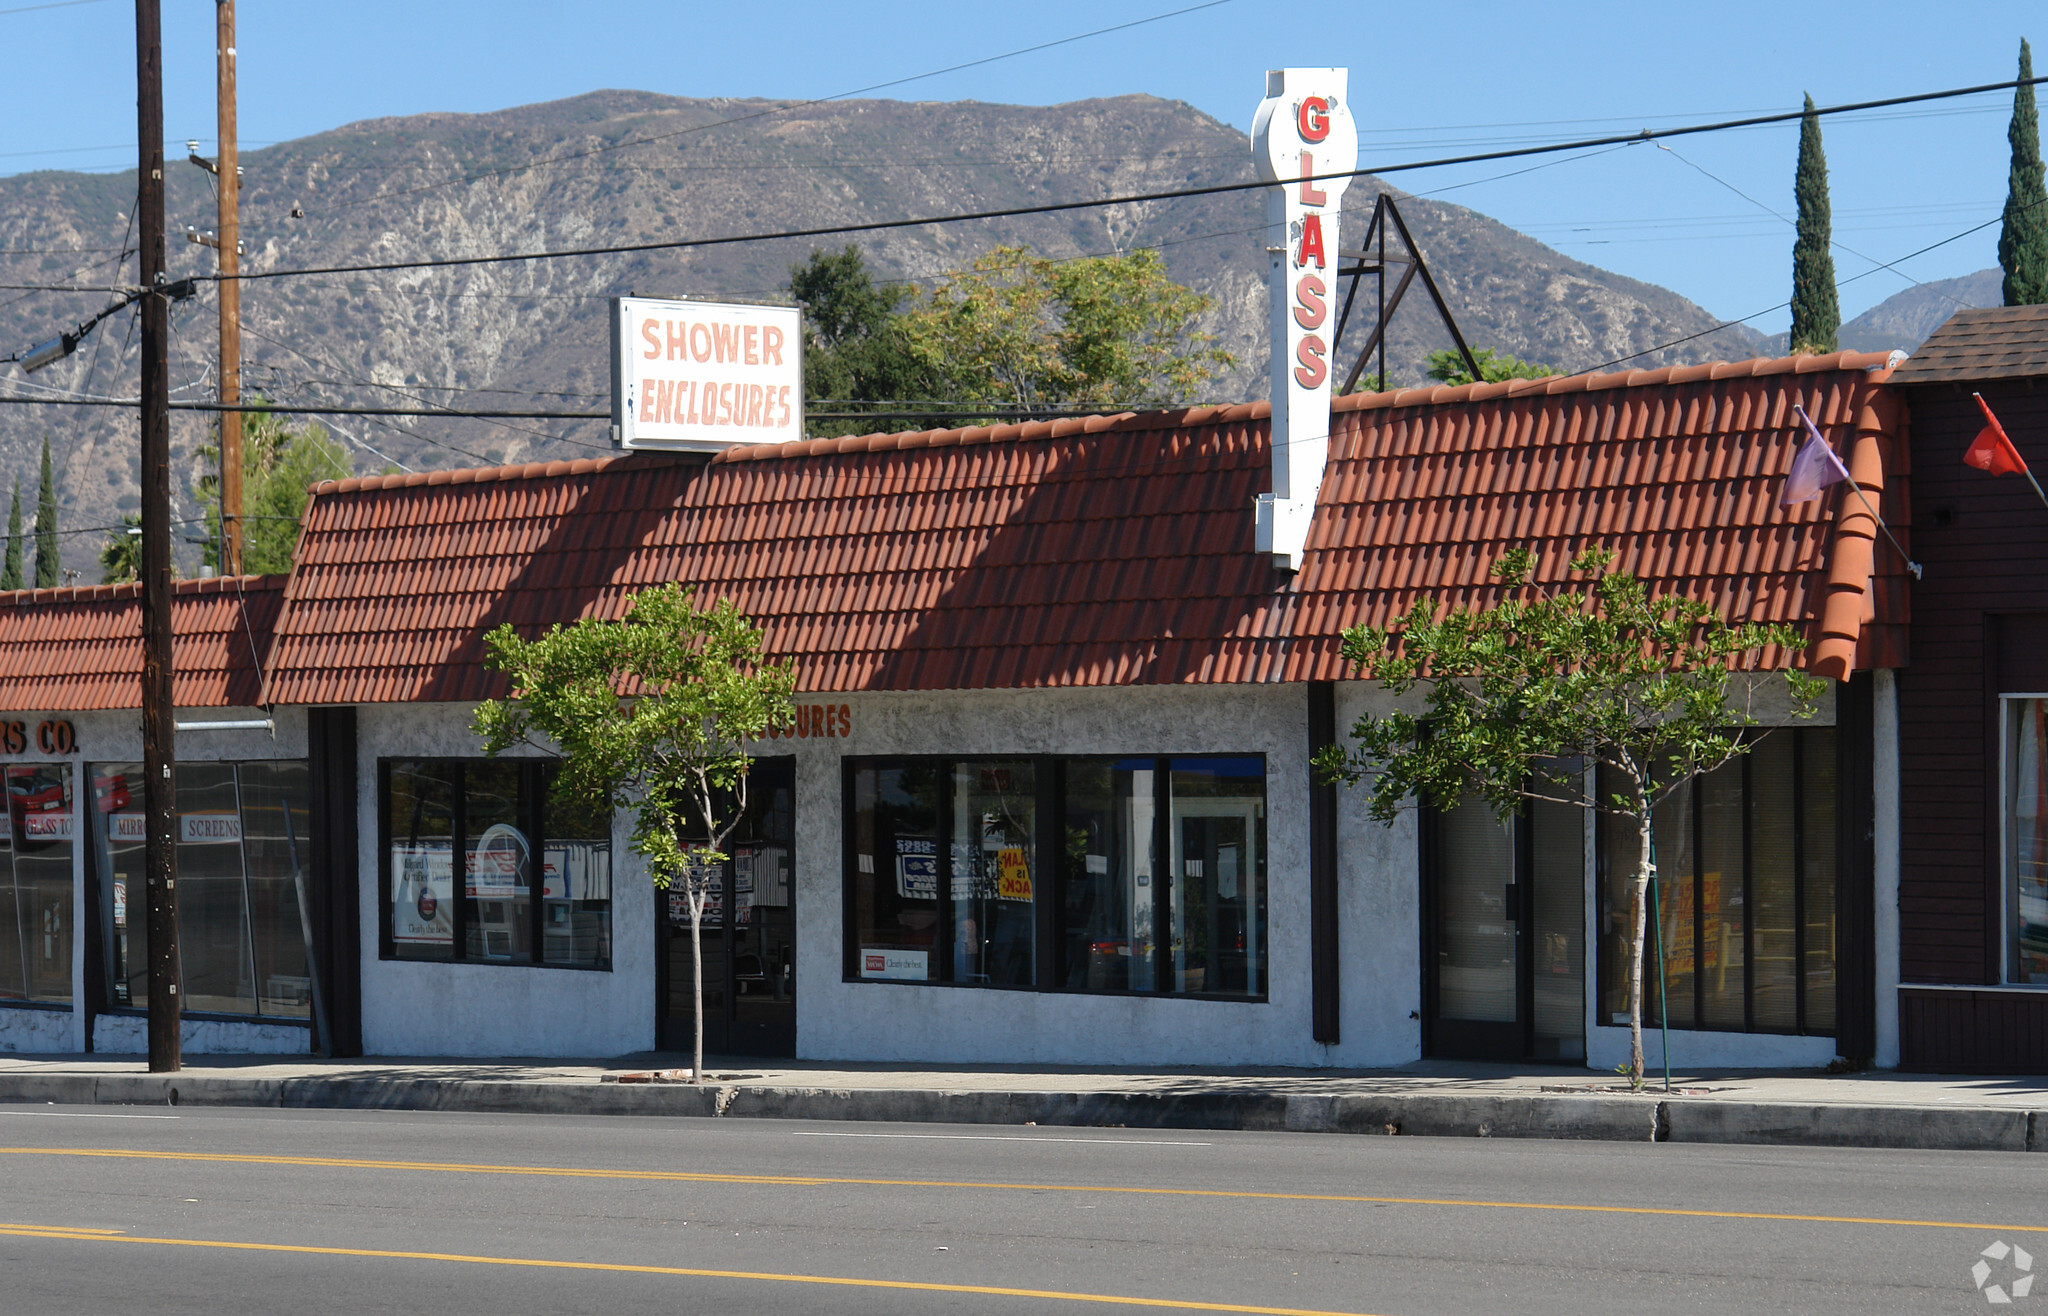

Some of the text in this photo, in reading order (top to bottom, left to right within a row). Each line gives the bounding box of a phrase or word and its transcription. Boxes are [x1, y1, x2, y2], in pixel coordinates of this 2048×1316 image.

[1294, 96, 1331, 389] GLASS
[641, 318, 784, 366] SHOWER
[640, 378, 791, 428] ENCLOSURES
[36, 720, 80, 754] CO.
[26, 818, 57, 835] GLASS
[118, 818, 146, 836] MIRR
[188, 819, 239, 837] SCREENS
